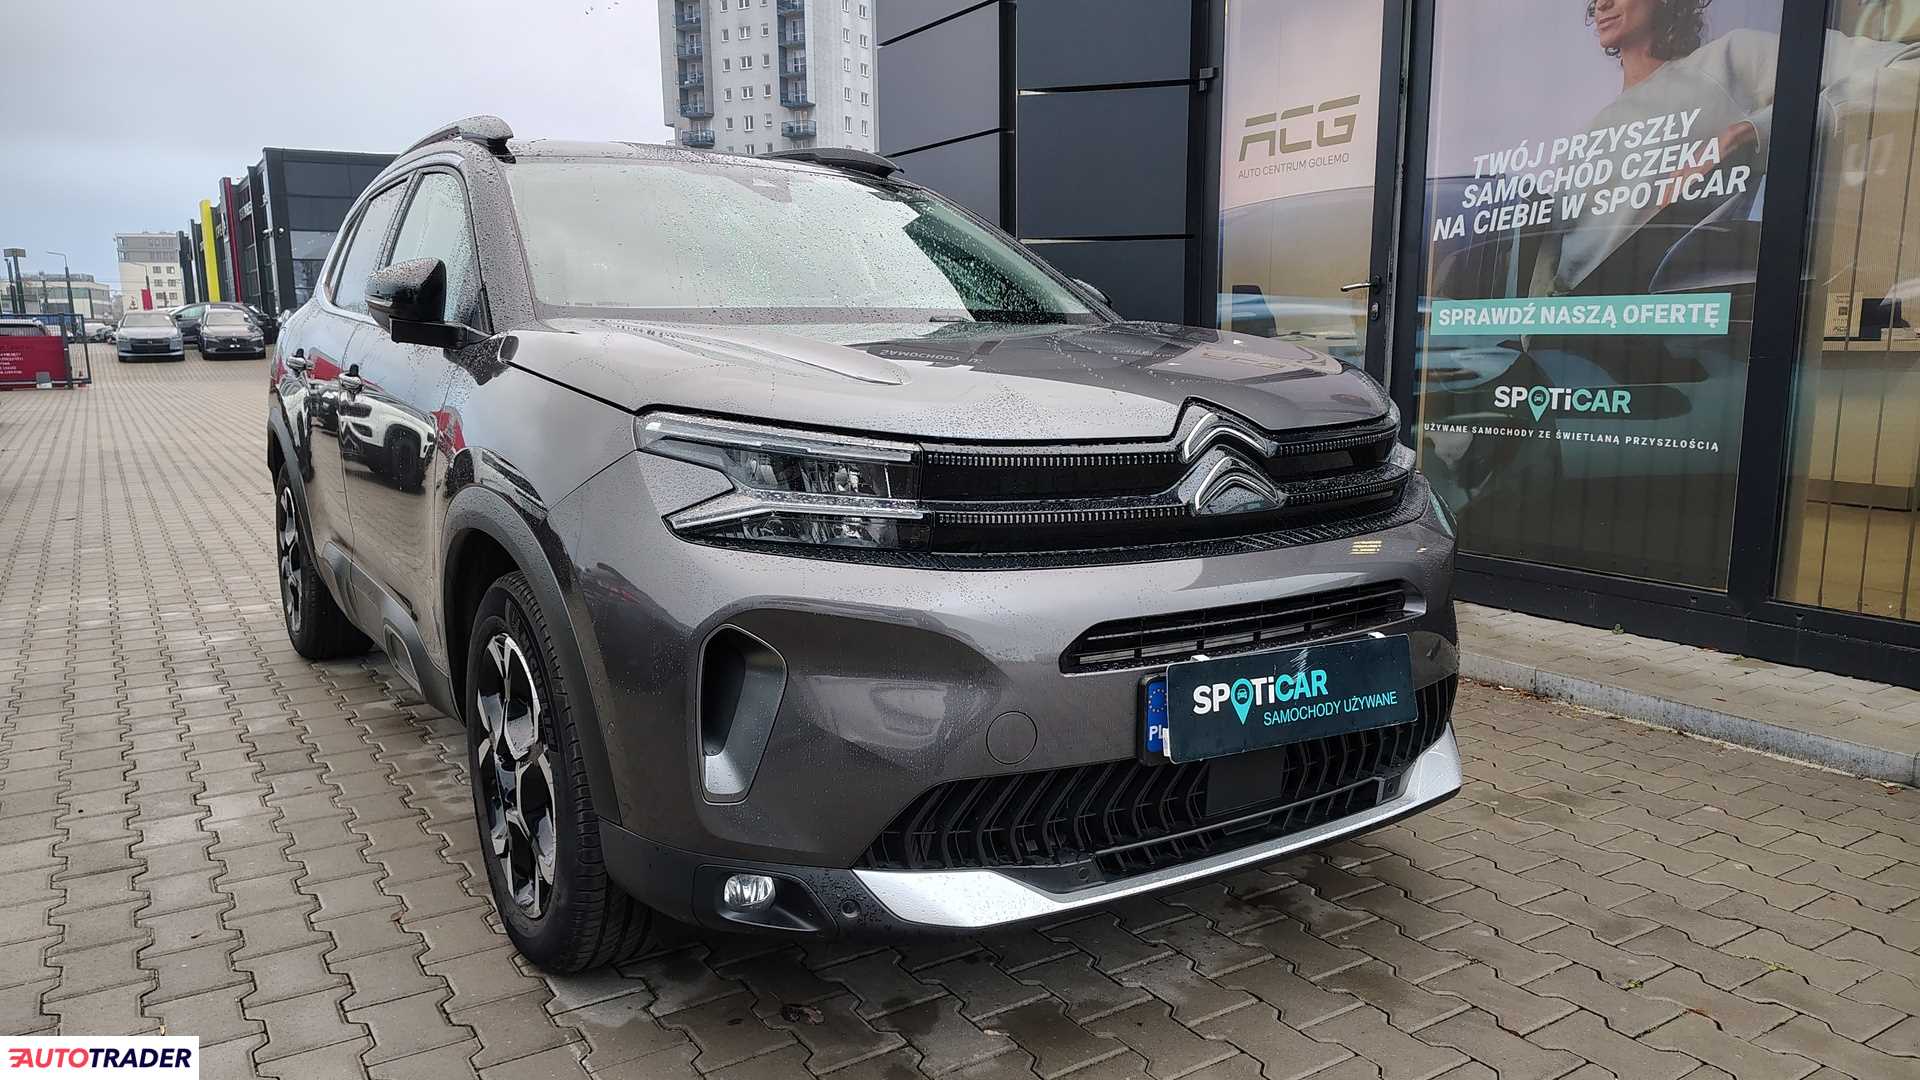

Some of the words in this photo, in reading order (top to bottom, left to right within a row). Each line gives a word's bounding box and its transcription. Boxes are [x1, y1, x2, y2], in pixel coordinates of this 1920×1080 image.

[1238, 94, 1361, 162] ACG
[1473, 140, 1547, 180] TWÓJ
[1550, 108, 1702, 164] PRZYSZŁY
[1238, 167, 1262, 179] AUTO
[1263, 159, 1307, 176] CENTRUM
[1308, 152, 1350, 168] GOLEMO
[1462, 152, 1613, 209] SAMOCHÓD
[1621, 137, 1722, 180] CZEKA
[1433, 217, 1467, 242] NA
[1473, 199, 1553, 235] CIEBIE
[1561, 196, 1586, 221] W
[1591, 165, 1751, 216] SPOTICAR
[1438, 303, 1536, 326] SPRAWDŹ
[1540, 303, 1618, 329] NASZĄ
[1623, 302, 1721, 328] OFERTĘ
[1424, 421, 1469, 434] UŻYWANE
[1471, 426, 1534, 438] SAMOCHODY
[1538, 430, 1552, 439] ZE
[1555, 429, 1620, 446] ŚWIETLANĄ
[1263, 698, 1342, 728] SAMOCHODY
[1344, 690, 1399, 714] UŻYWANE
